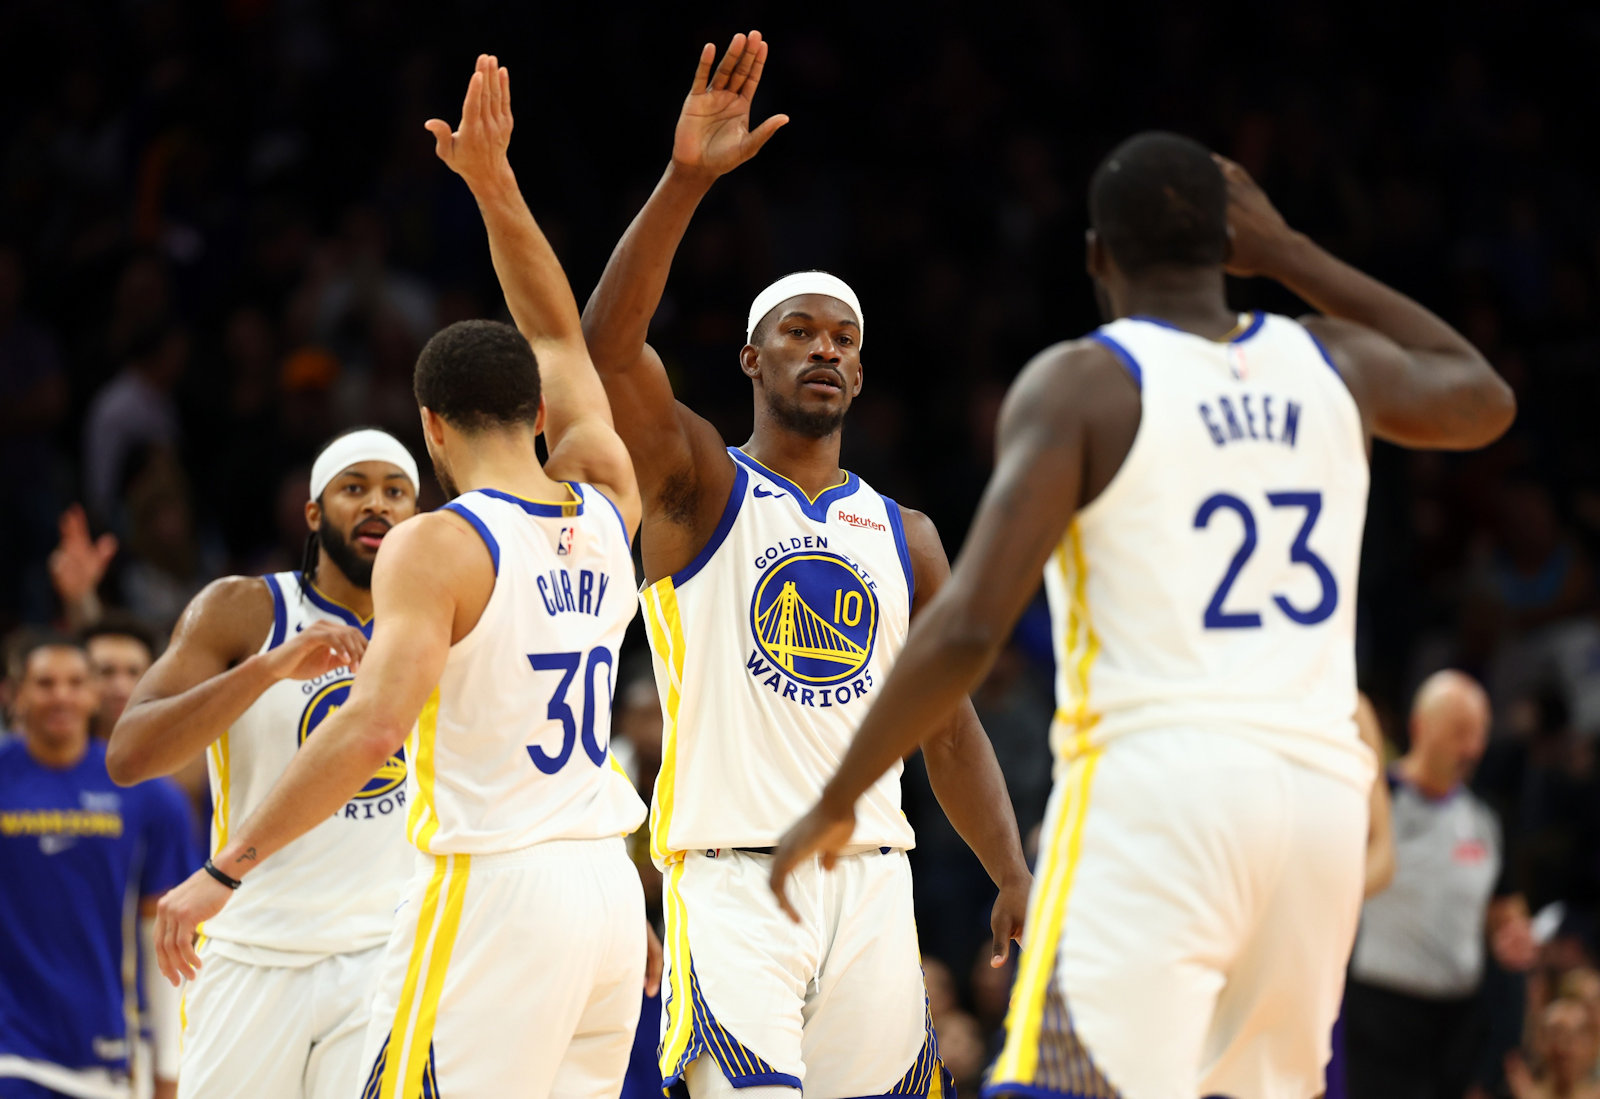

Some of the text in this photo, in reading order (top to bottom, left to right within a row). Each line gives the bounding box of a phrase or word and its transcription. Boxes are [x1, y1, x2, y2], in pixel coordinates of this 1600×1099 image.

[1198, 394, 1301, 448] GREEN
[838, 510, 886, 532] Rakuten
[754, 536, 828, 569] GOLDEN
[1193, 490, 1338, 629] 23
[536, 569, 609, 617] CURRY
[833, 588, 863, 627] 10
[302, 664, 354, 695] GOLD
[746, 650, 873, 707] WARRIORS
[526, 646, 612, 774] 30
